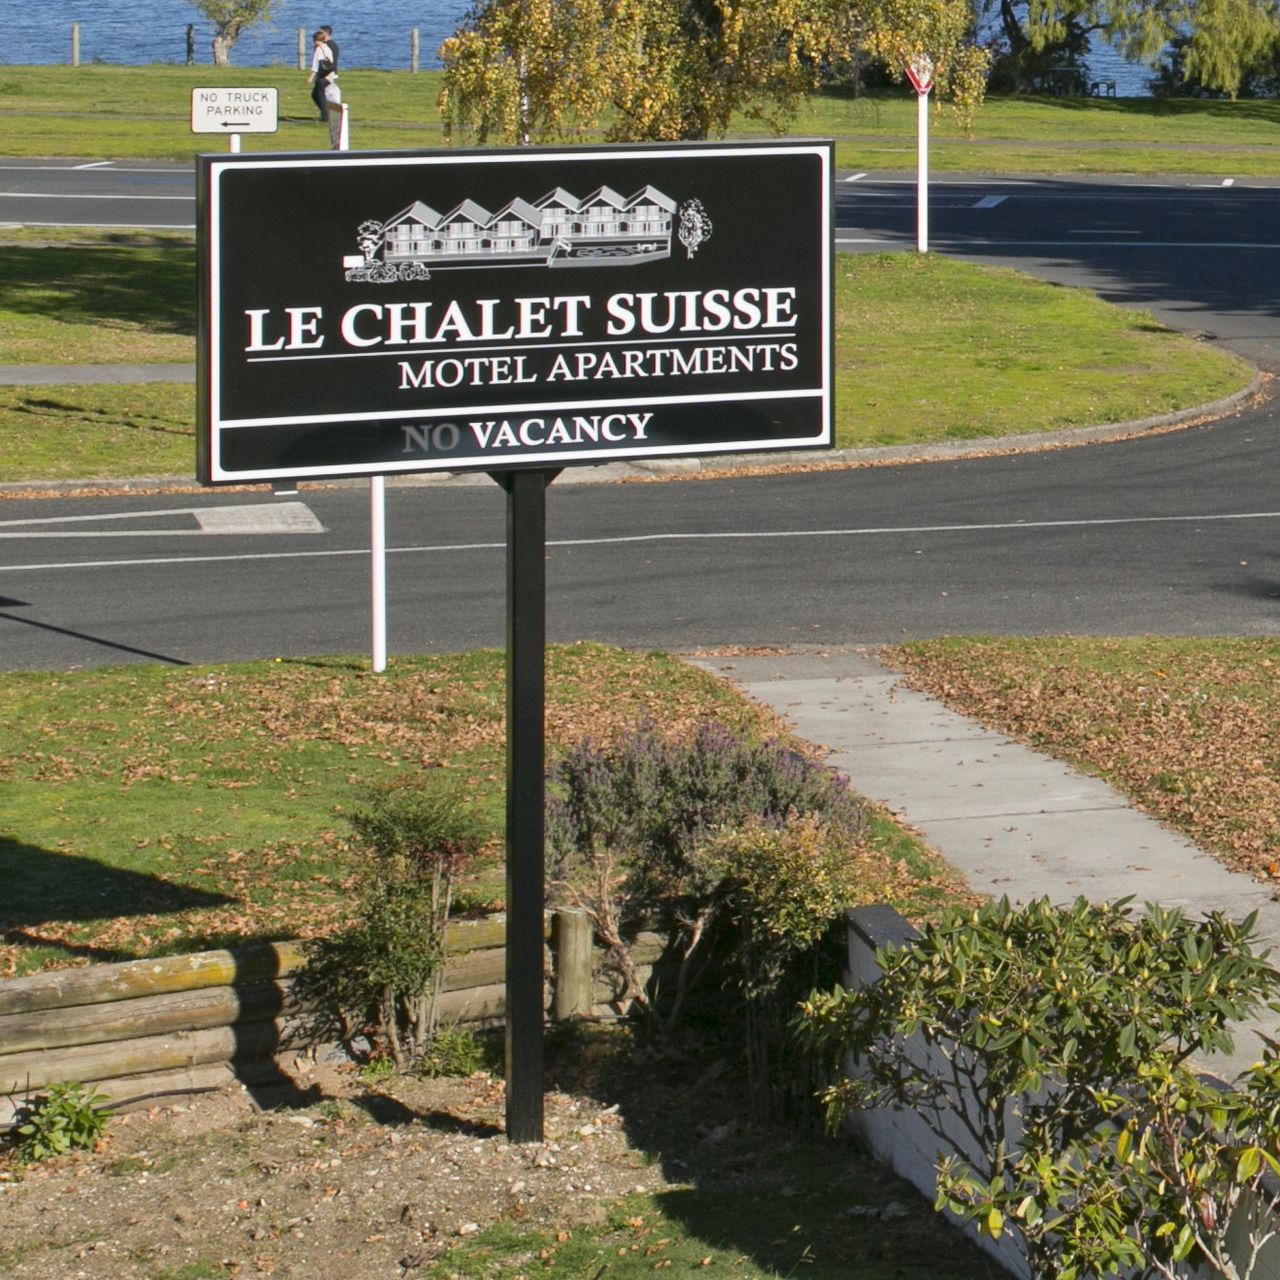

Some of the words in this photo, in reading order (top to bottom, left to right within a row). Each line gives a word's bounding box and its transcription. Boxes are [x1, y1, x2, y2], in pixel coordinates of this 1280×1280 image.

[200, 93, 218, 102] NO
[227, 93, 269, 102] TRUCK
[206, 106, 263, 116] PARKING
[244, 305, 325, 352] LE
[339, 294, 593, 348] CHALET
[606, 285, 799, 336] SUISSE
[398, 355, 537, 390] MOTEL
[546, 342, 800, 384] APARTMENTS
[402, 423, 460, 454] NO
[469, 412, 654, 449] VACANCY
